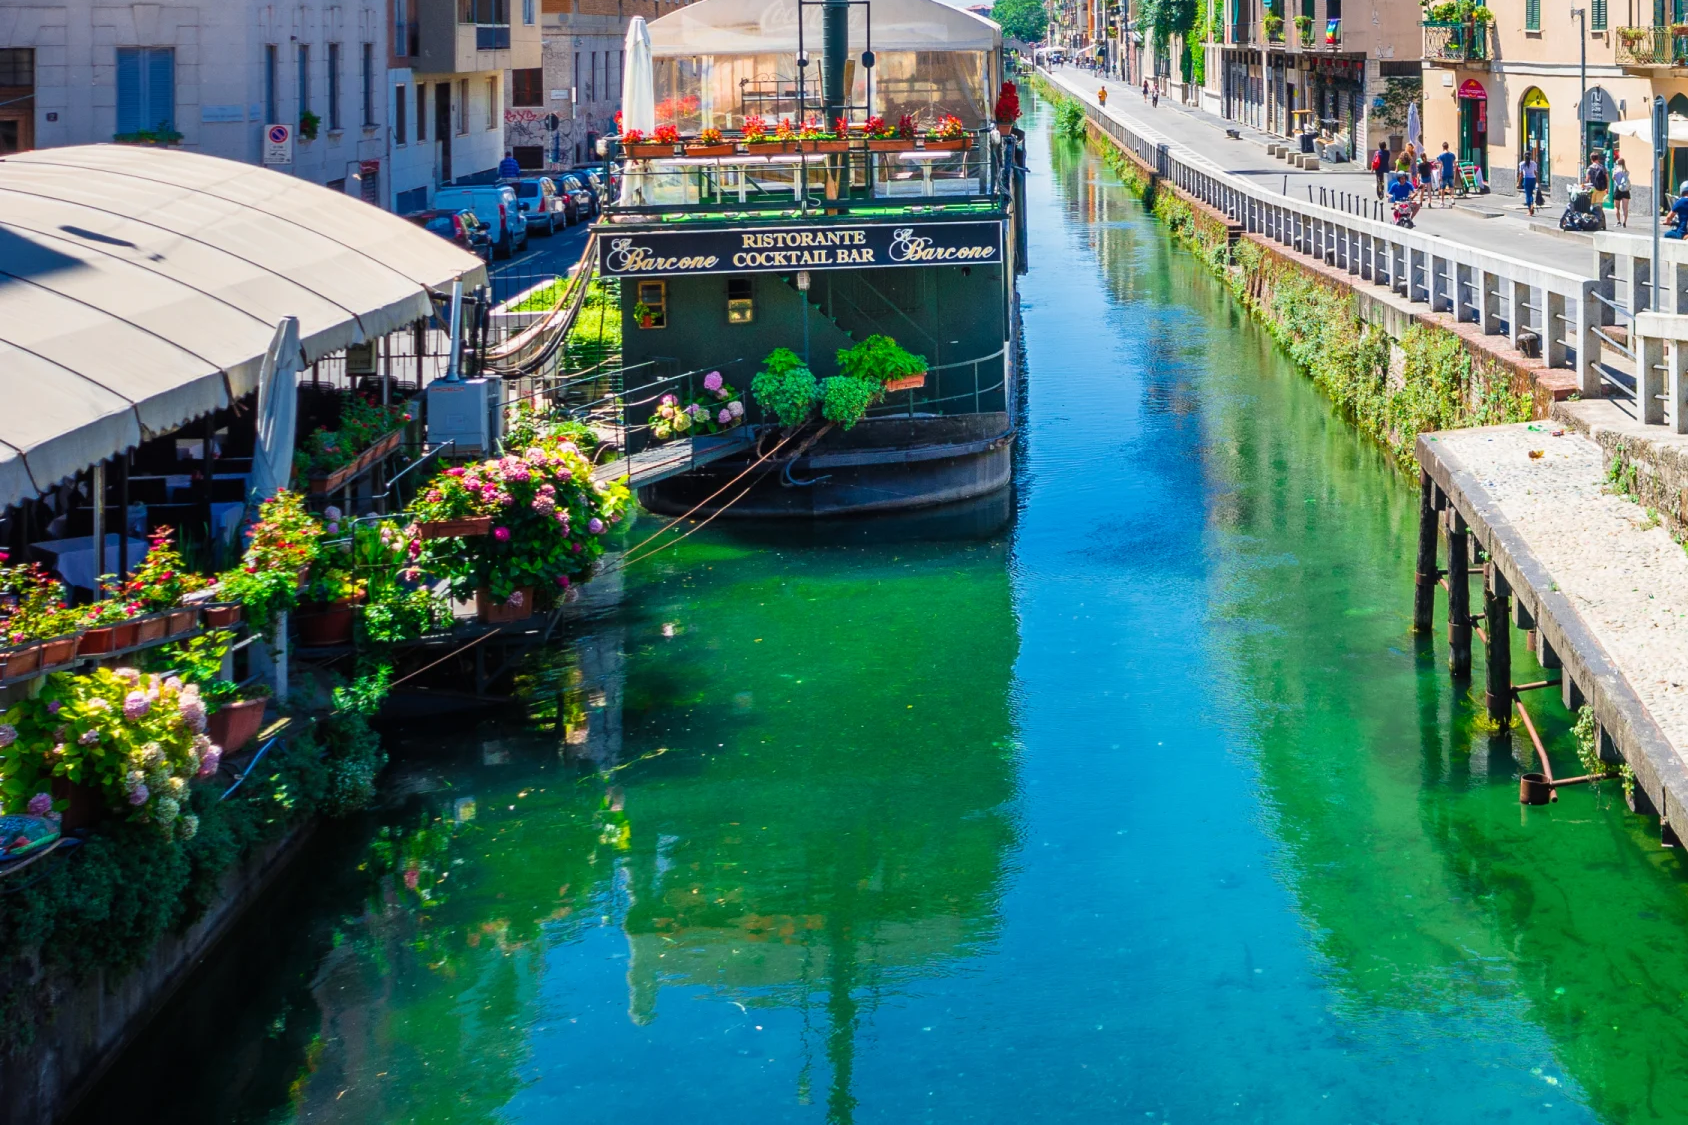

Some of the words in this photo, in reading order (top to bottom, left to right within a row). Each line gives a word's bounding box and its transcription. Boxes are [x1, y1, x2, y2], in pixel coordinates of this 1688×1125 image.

[742, 230, 866, 249] RISTORANTE
[888, 237, 997, 262] Barcone
[606, 247, 720, 272] Barcone
[732, 249, 834, 267] COCKTAIL
[836, 248, 876, 263] BAR
